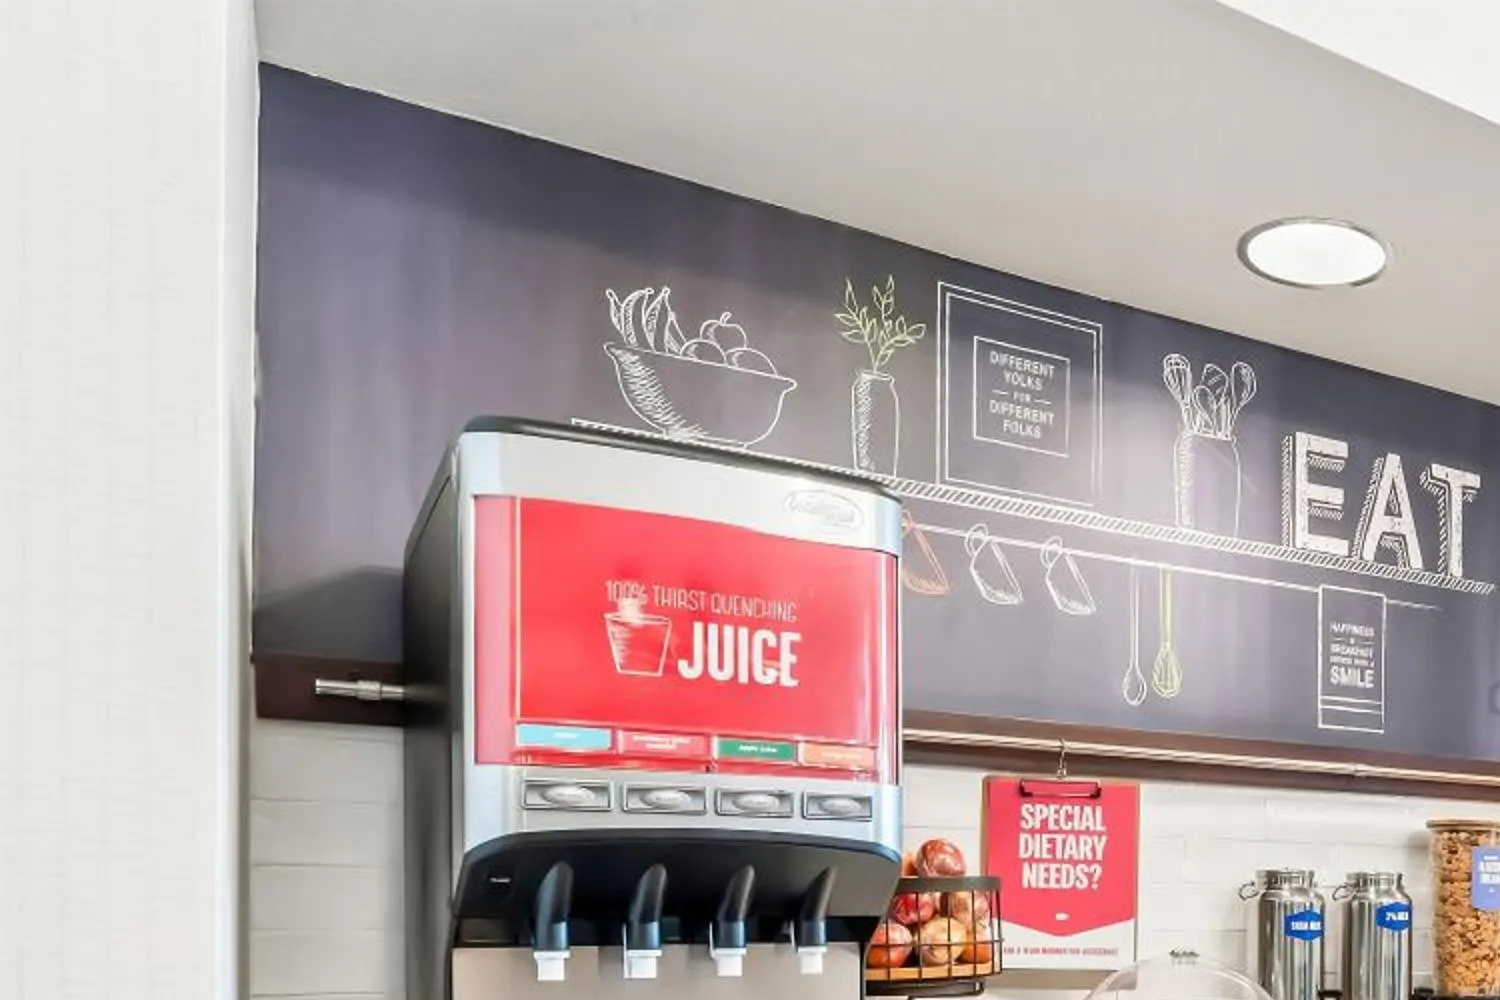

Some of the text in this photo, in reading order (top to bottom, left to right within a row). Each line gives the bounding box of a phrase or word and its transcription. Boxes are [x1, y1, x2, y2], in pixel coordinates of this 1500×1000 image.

[990, 351, 1055, 378] DIFFERENT
[1003, 368, 1042, 390] YOLKS
[989, 399, 1055, 425] DIFFERENT
[1003, 419, 1041, 438] FOLKS
[1281, 431, 1481, 577] EAT
[652, 585, 708, 611] THIRST
[711, 592, 797, 623] QUENCHING
[677, 620, 802, 688] JUICE
[1330, 665, 1375, 688] SMILE
[1020, 803, 1107, 832] SPECIAL
[1019, 833, 1108, 860] DIETARY
[1022, 863, 1102, 889] NEEDS?
